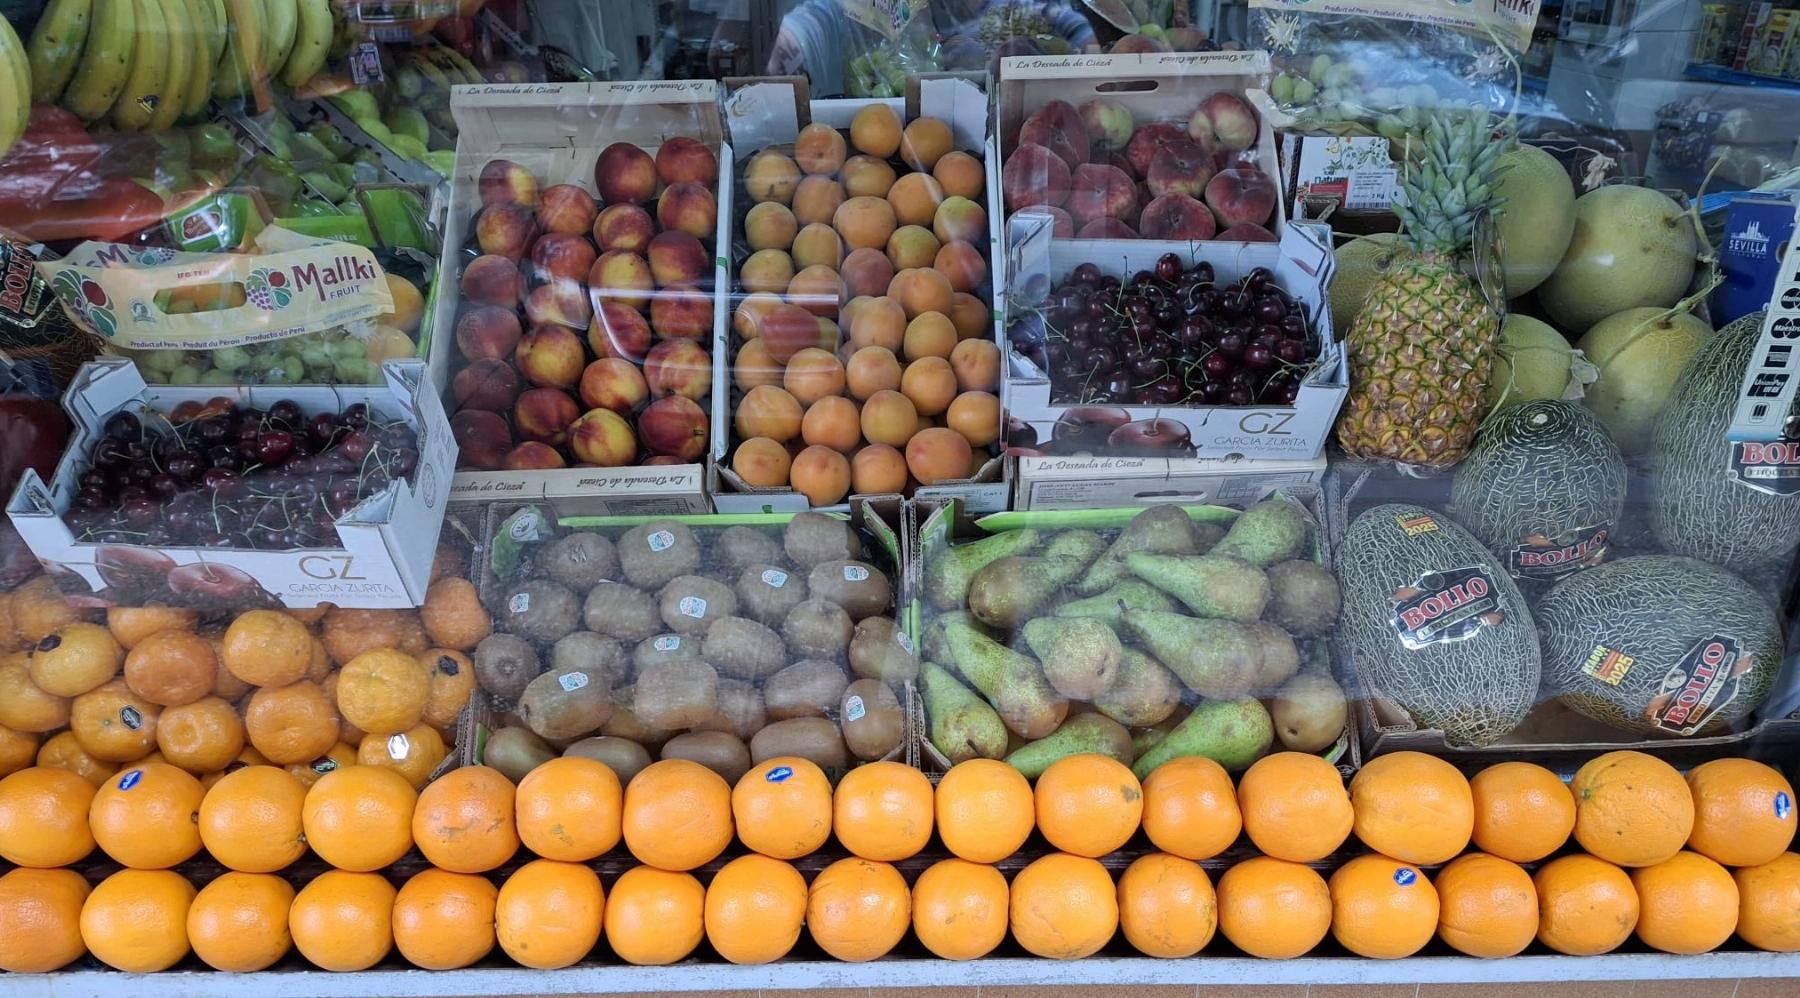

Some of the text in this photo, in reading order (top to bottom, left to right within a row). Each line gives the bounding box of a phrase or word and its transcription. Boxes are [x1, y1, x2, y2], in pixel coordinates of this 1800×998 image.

[1016, 59, 1030, 69] La
[1072, 58, 1084, 68] de
[467, 86, 480, 94] La
[1729, 240, 1767, 253] SEVILLA
[291, 256, 376, 302] Mallki
[330, 284, 361, 299] FRUIT
[245, 331, 278, 343] Producto
[1239, 412, 1297, 435] GZ
[1265, 437, 1306, 447] ZURITA
[1740, 442, 1800, 464] BOL
[1038, 460, 1054, 471] La
[1056, 459, 1099, 470] Deseada
[1100, 458, 1115, 469] de
[479, 481, 493, 493] de
[609, 476, 623, 486] de
[624, 475, 668, 486] Deseada
[669, 475, 687, 486] La
[1404, 520, 1439, 536] 2025
[299, 556, 367, 580] GZ
[345, 583, 394, 593] ZURITA
[1400, 577, 1489, 632] BOLLO
[1605, 654, 1634, 686] 2025
[1663, 643, 1726, 726] BOLLO
